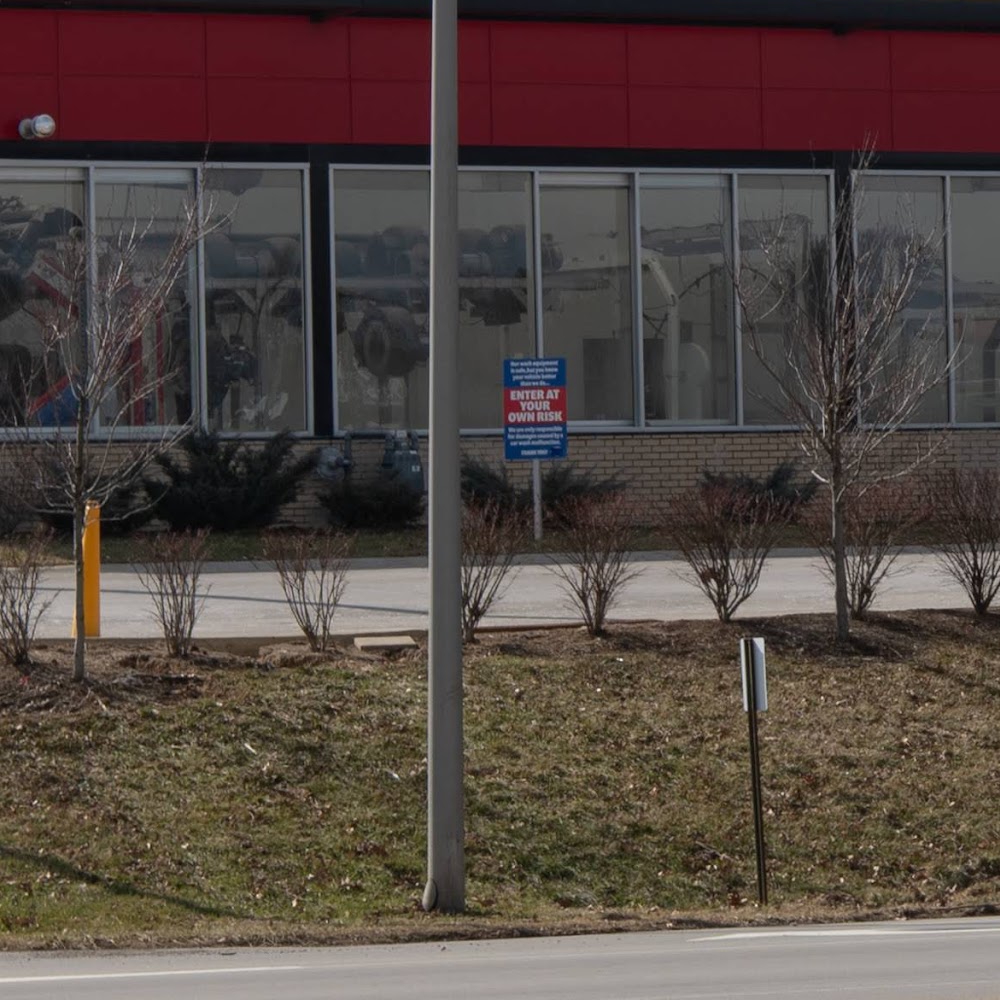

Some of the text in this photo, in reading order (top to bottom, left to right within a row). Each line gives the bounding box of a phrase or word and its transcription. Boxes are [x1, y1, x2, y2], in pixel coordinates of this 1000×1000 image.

[510, 389, 560, 401] ENTER AT
[520, 400, 551, 411] YOUR
[508, 410, 563, 423] OWN RISK
